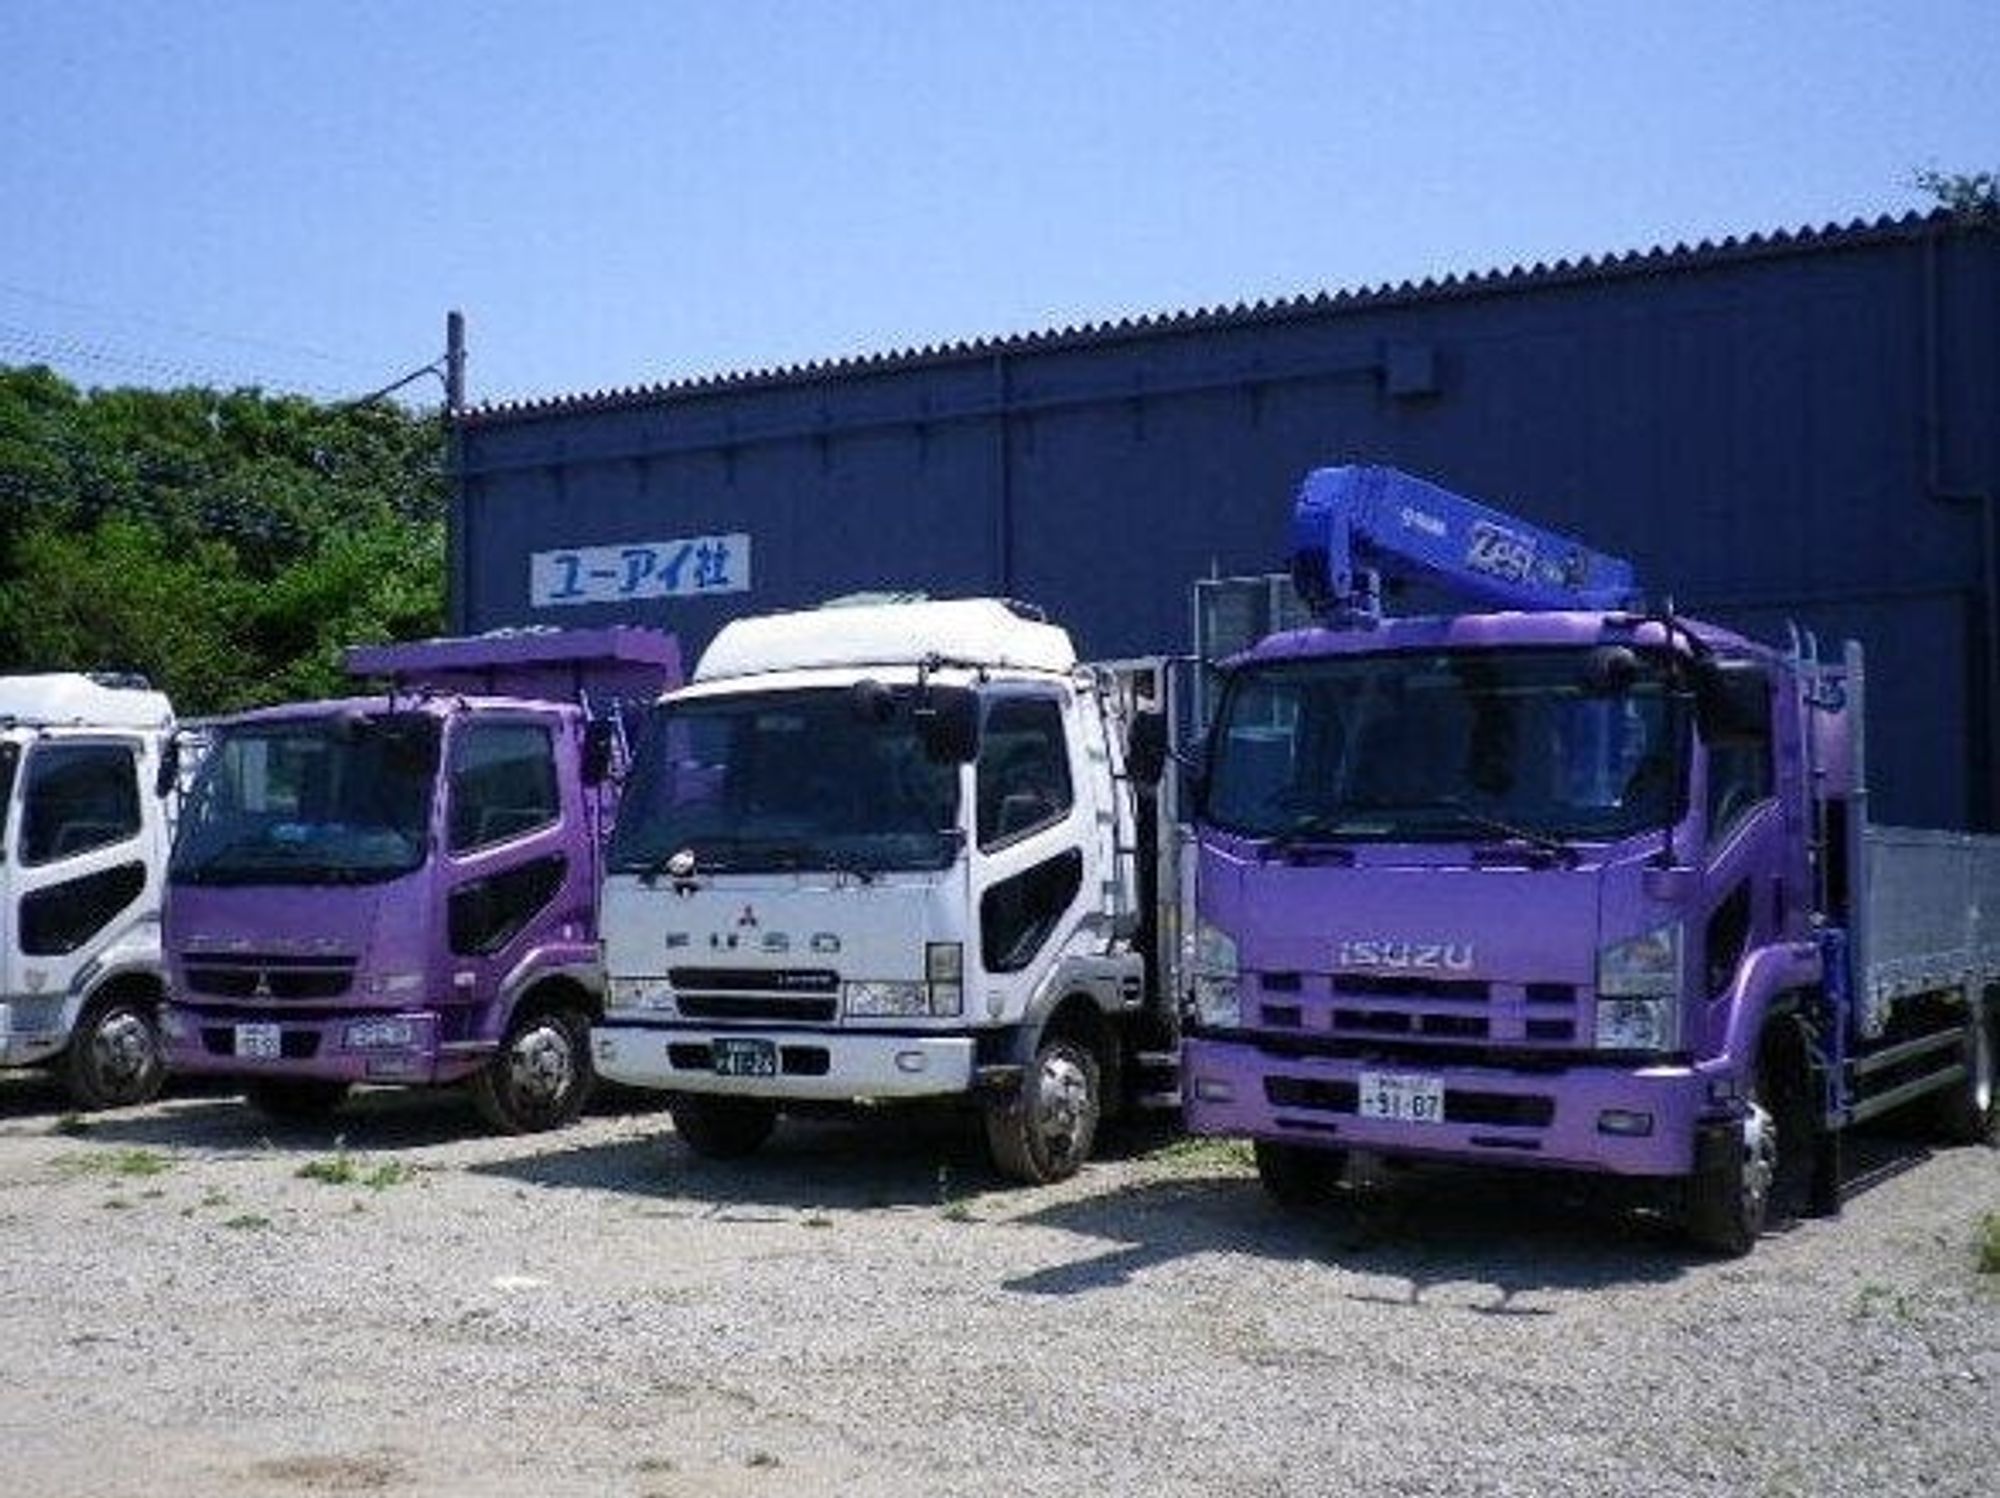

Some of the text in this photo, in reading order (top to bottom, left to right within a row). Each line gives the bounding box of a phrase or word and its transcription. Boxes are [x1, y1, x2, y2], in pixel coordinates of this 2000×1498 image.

[549, 541, 733, 598] ユーアイ社
[665, 931, 842, 953] FUSO
[1339, 941, 1474, 970] ISUZU
